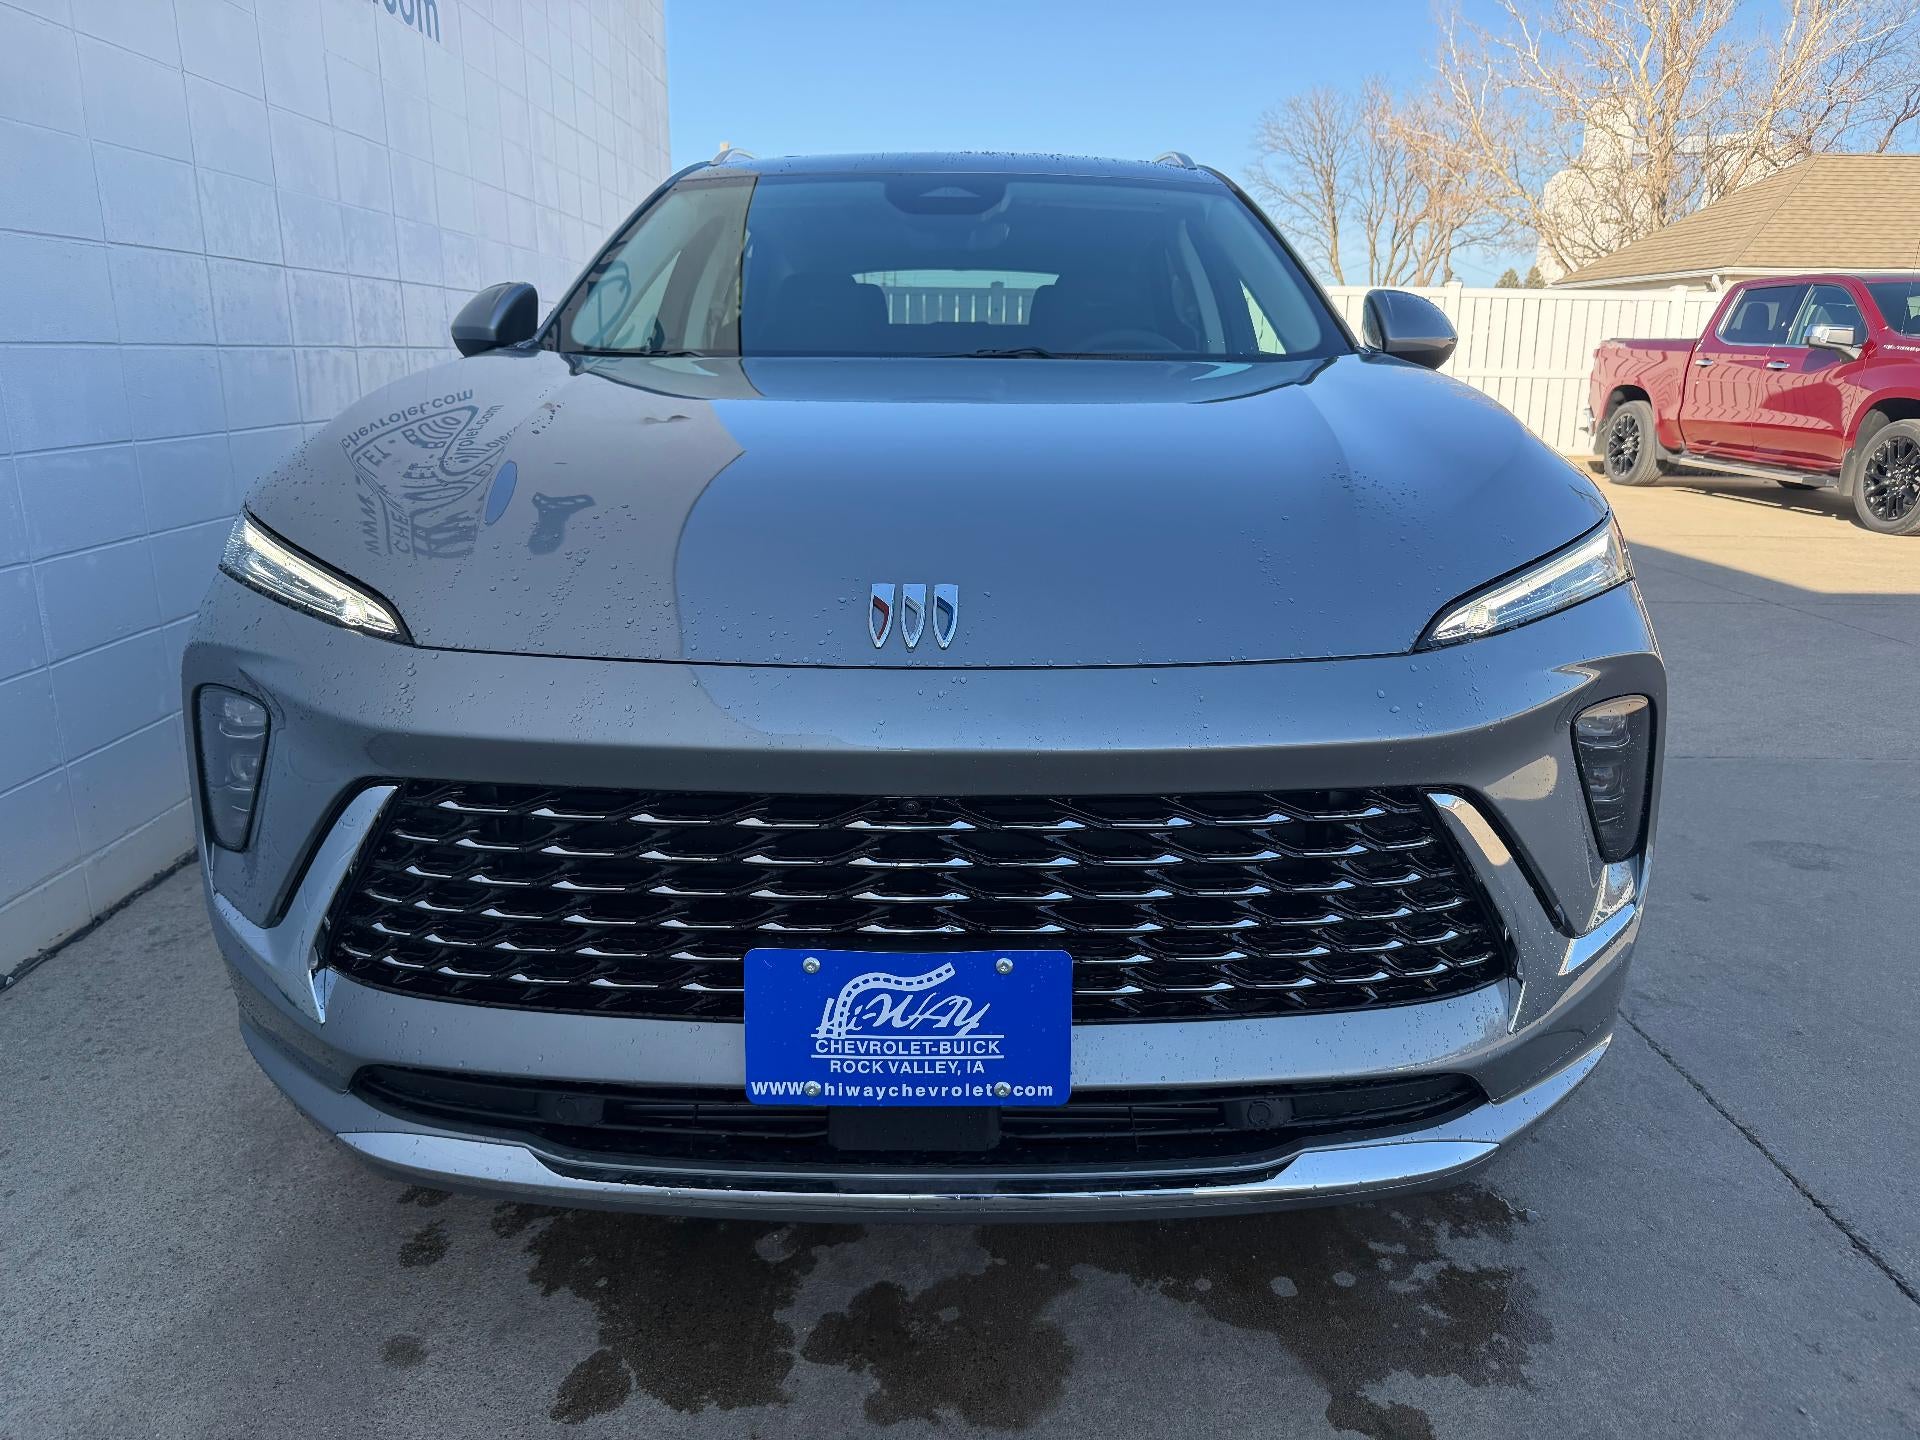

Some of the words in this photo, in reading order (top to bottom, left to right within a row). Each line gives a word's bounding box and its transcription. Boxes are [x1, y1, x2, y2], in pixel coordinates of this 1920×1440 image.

[815, 1039, 1001, 1056] CHEVROLET-BUICK
[830, 1059, 885, 1074] ROCK
[888, 1060, 961, 1076] VALLEY,
[966, 1060, 985, 1074] IA
